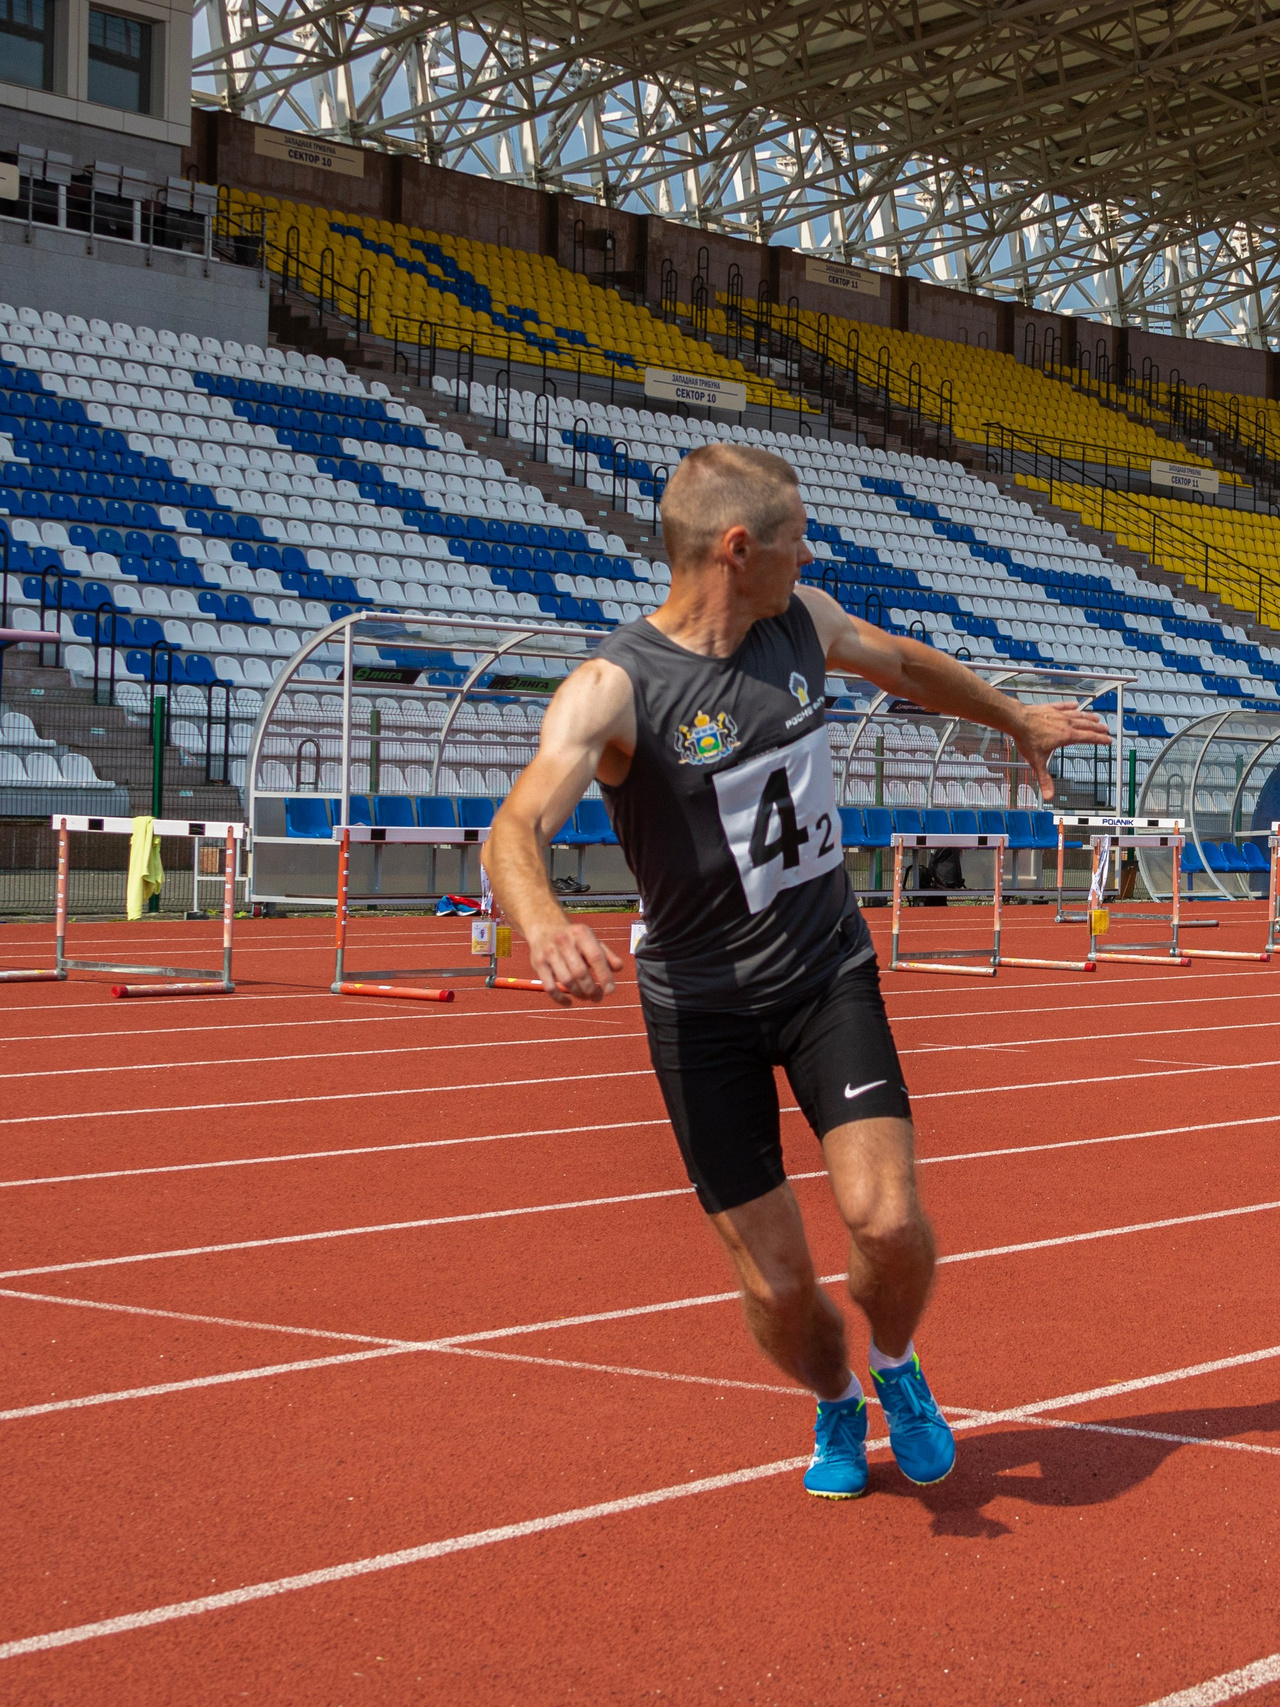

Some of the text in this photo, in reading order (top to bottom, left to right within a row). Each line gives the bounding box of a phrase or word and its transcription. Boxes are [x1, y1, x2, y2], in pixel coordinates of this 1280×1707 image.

[288, 149, 332, 167] СЕКТОР 10
[828, 275, 850, 286] СЕКТОР
[672, 374, 720, 390] ЗАПАДНАЯ ТРИБУНА
[676, 388, 717, 403] СЕКТОР 10
[1171, 475, 1191, 486] СЕКТОР
[748, 766, 835, 870] 4 2
[1102, 818, 1134, 826] POLANIK
